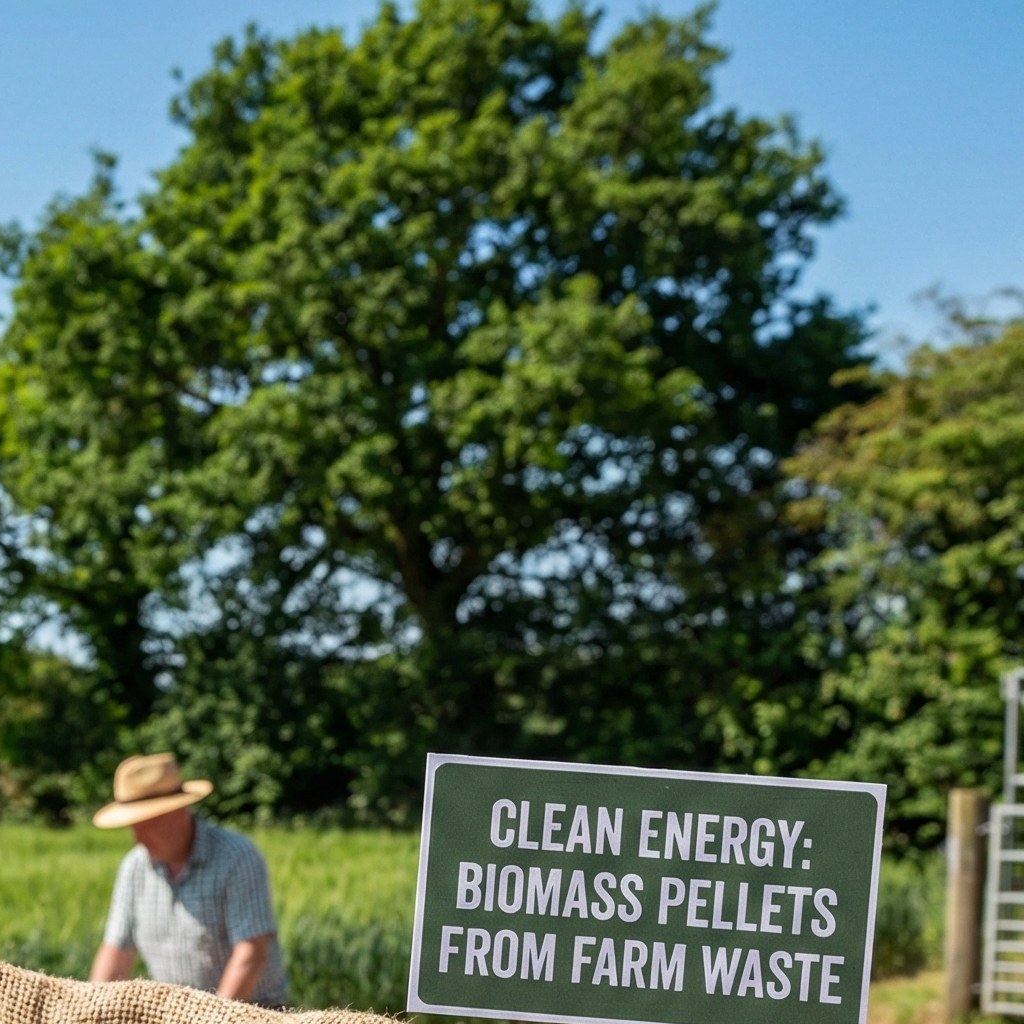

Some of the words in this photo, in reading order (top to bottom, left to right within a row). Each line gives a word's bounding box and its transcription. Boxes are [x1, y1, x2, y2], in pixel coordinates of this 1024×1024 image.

[490, 799, 623, 855] CLEAN
[639, 810, 812, 869] ENERGY:
[456, 862, 643, 922] BIOMASS
[658, 877, 837, 937] PELLETS
[439, 926, 556, 981] FROM
[571, 936, 686, 991] FARM
[702, 946, 844, 1004] WASTE
